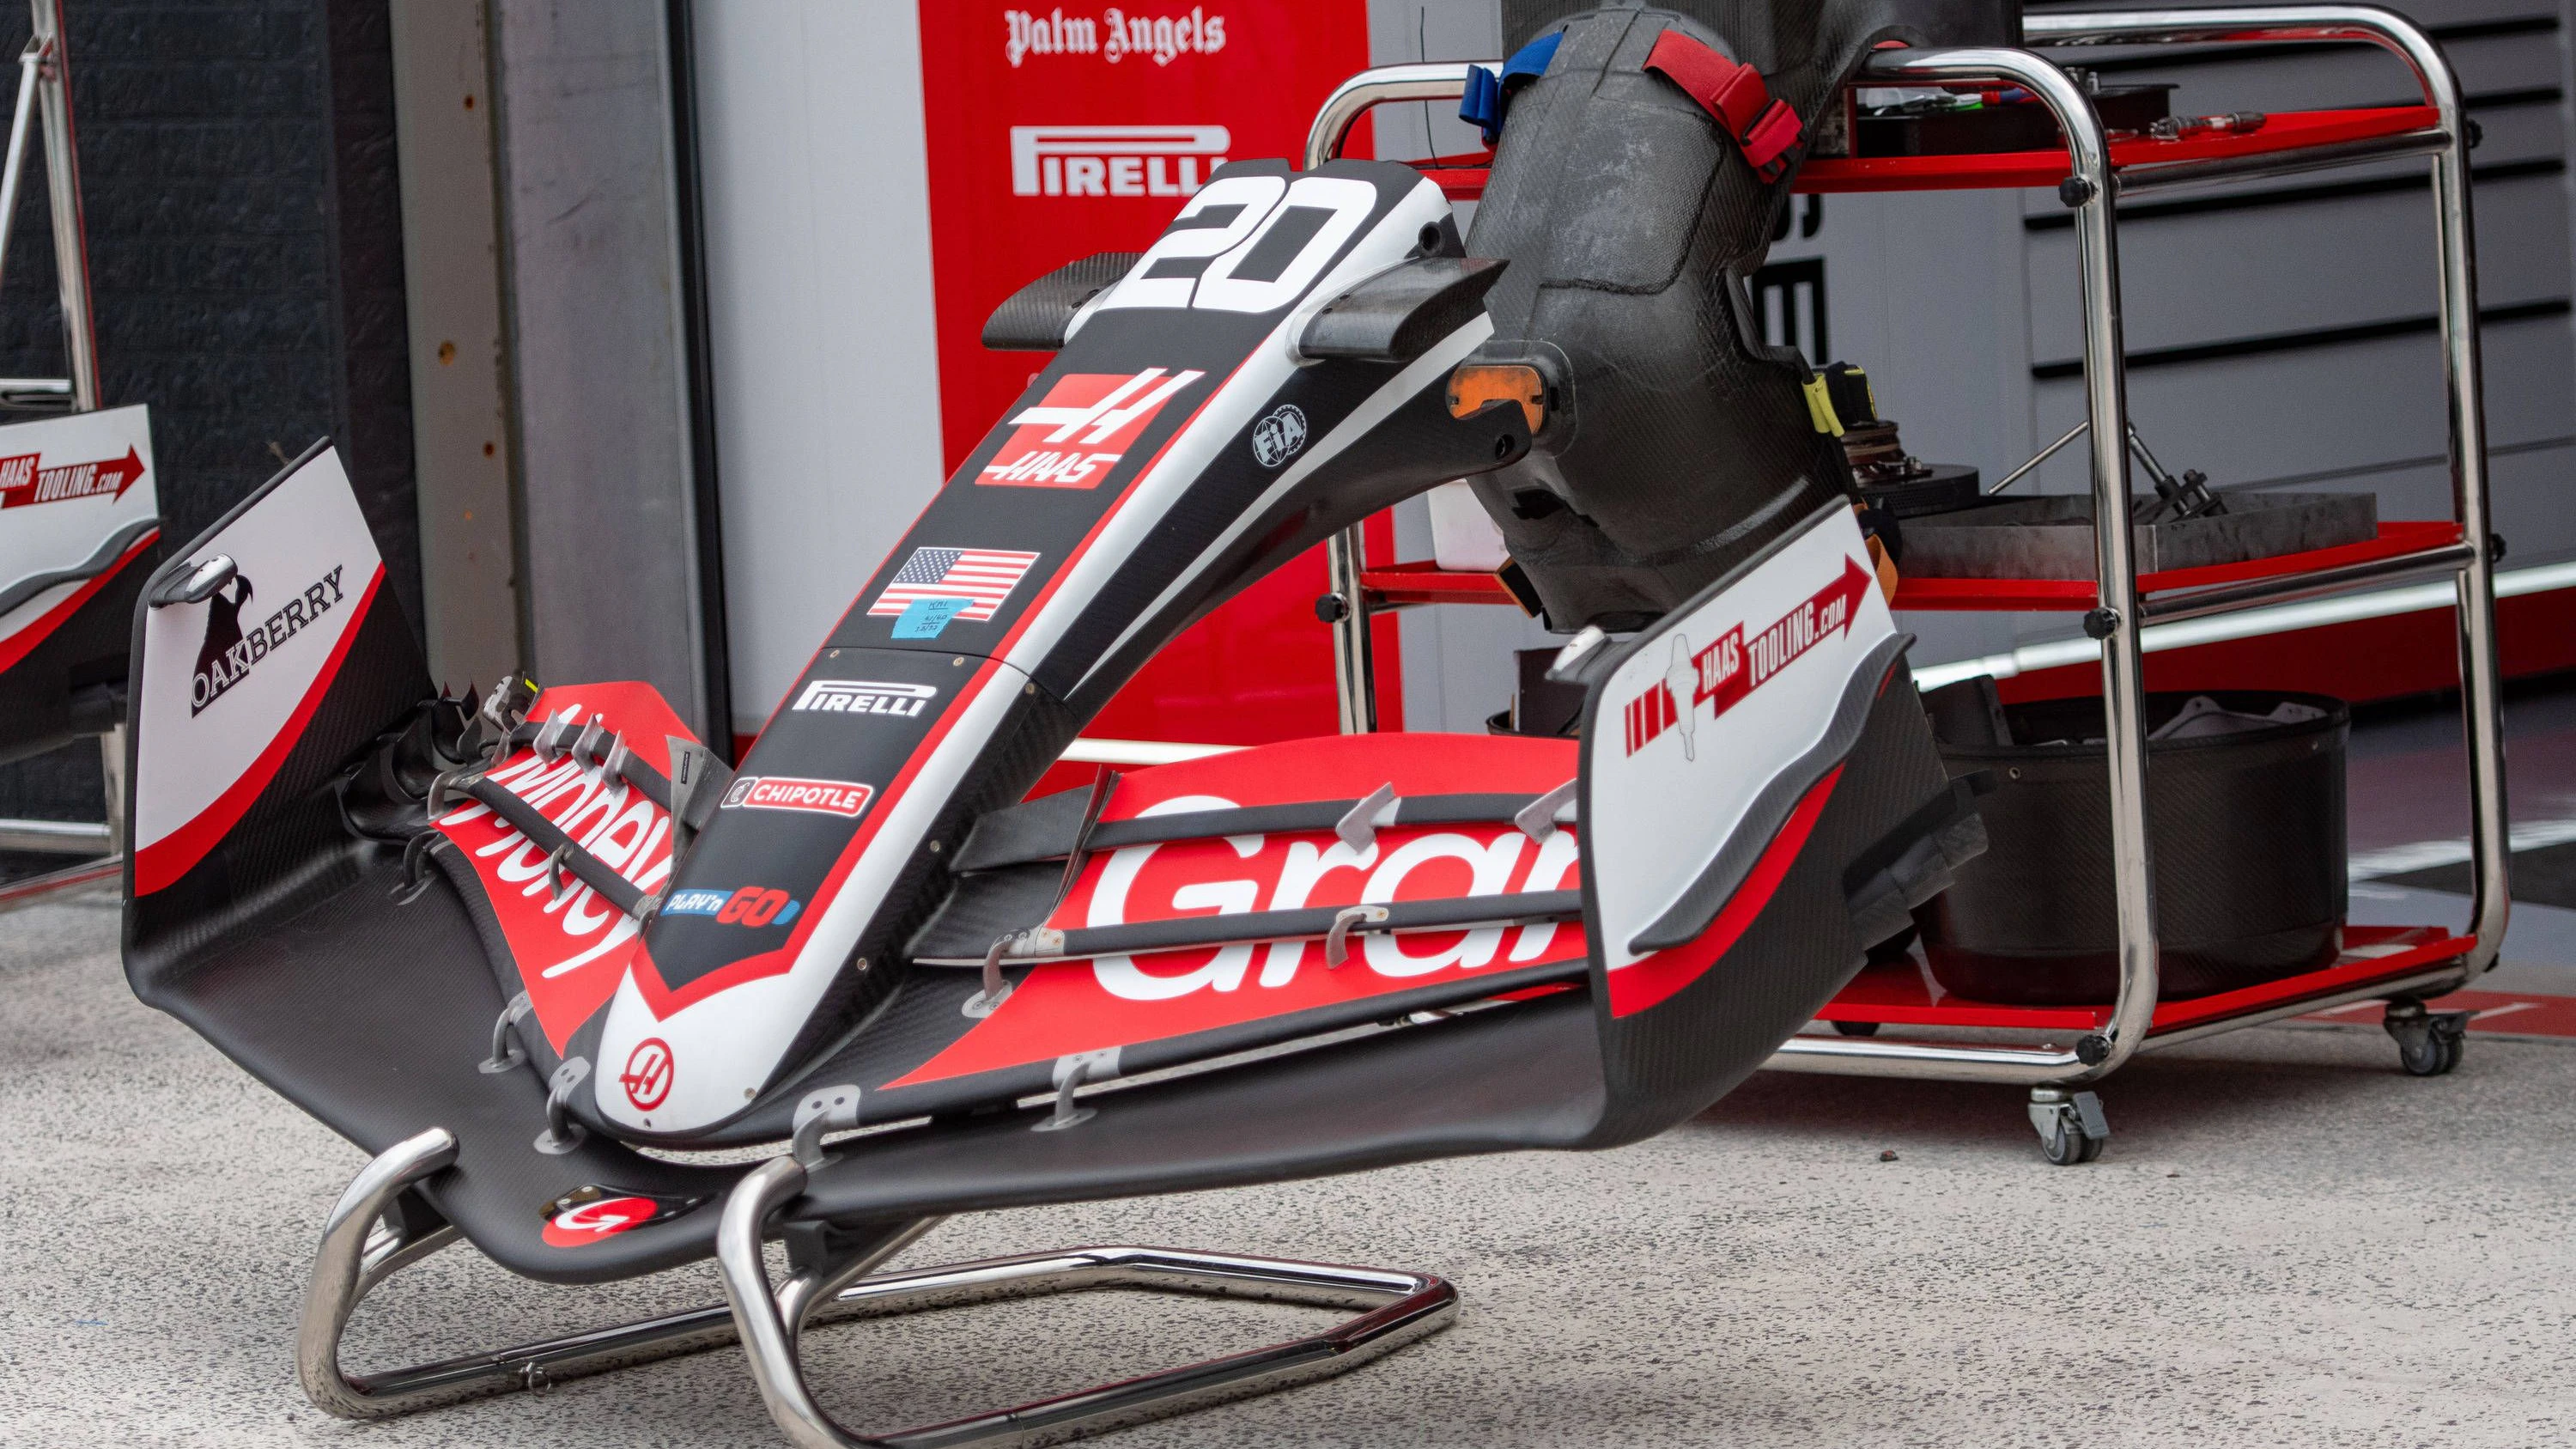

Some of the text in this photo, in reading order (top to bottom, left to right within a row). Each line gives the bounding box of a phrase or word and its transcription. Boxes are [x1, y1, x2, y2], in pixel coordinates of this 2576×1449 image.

[1004, 5, 1227, 68] Palm Angels
[1094, 175, 1378, 314] 20
[982, 451, 1122, 483] HAAS
[191, 563, 343, 708] OAKBERRY
[1702, 631, 1740, 693] HAAS
[792, 680, 938, 717] PIRELLI
[753, 783, 863, 810] CHIPOTLE
[715, 886, 790, 928] GO
